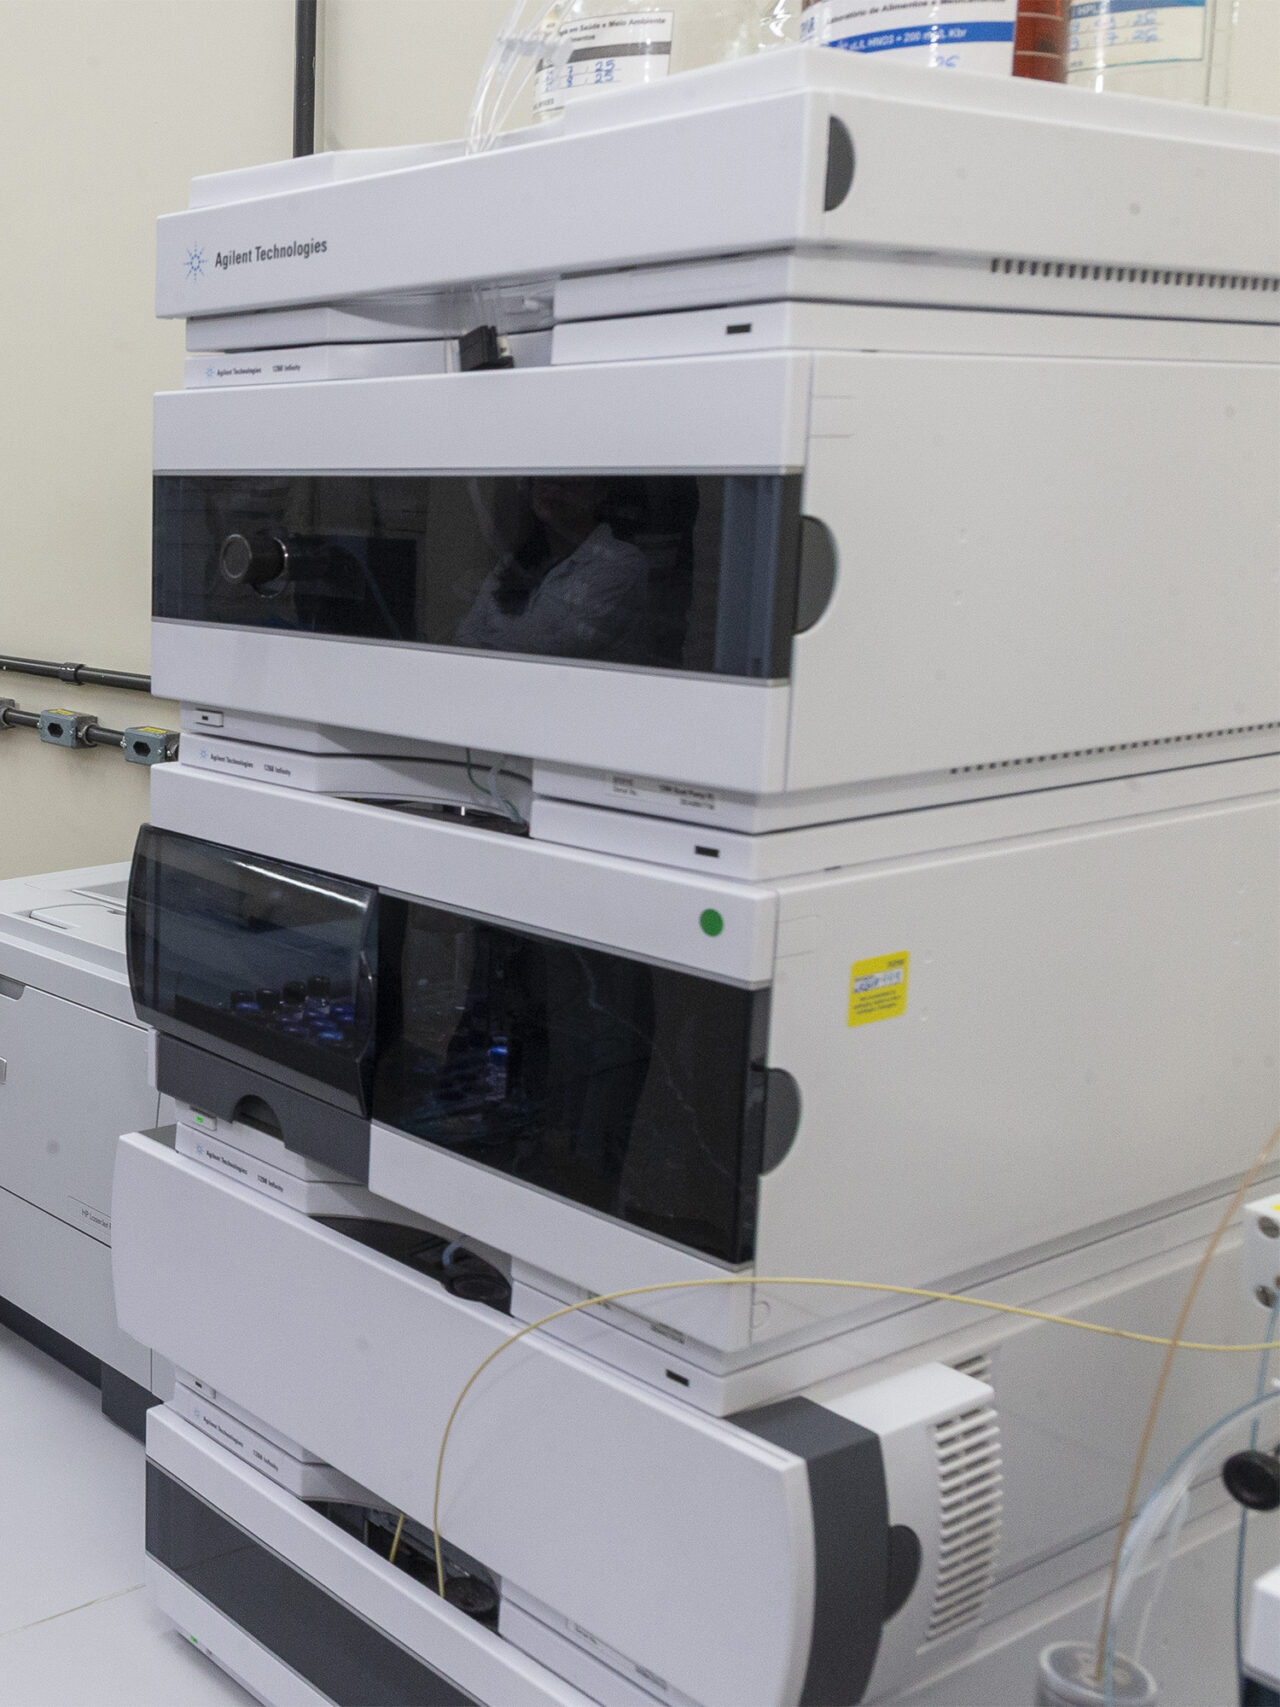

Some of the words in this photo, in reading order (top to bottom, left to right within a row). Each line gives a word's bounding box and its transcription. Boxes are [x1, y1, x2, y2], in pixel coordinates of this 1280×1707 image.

[882, 1, 927, 13] Alimentos
[580, 22, 601, 32] Saúde
[608, 18, 627, 28] Meio
[629, 17, 666, 26] Ambiente
[215, 249, 252, 270] Agilent
[255, 238, 327, 262] Technologies
